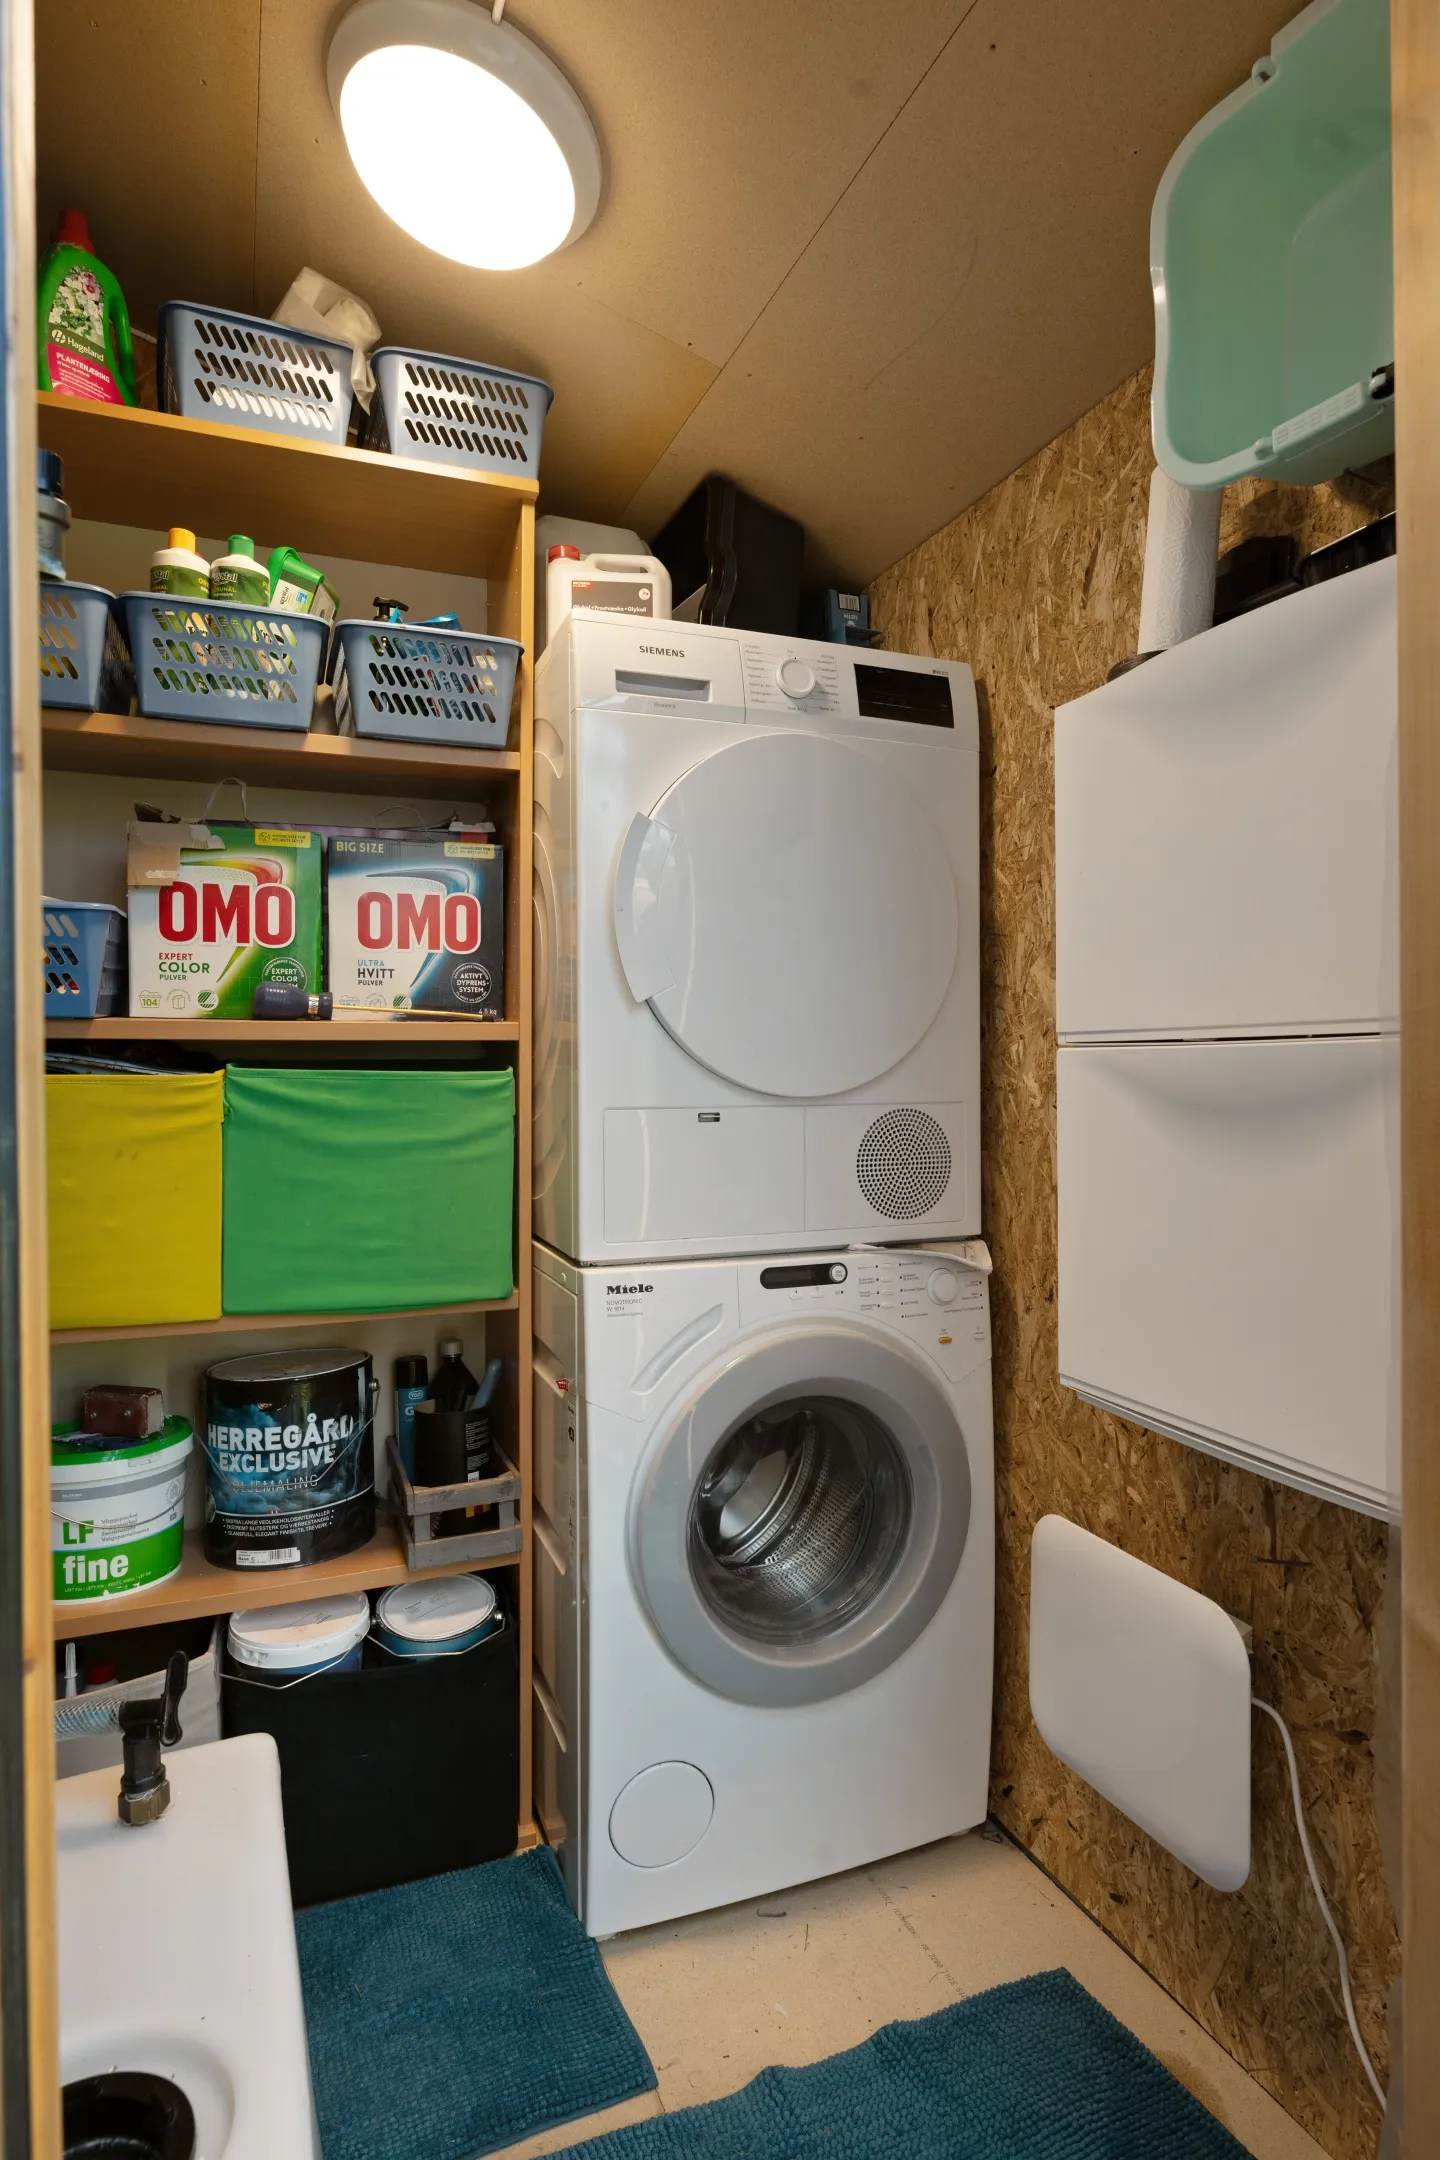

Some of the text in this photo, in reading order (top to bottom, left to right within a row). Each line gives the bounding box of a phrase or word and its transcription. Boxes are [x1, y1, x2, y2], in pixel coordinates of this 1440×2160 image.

[68, 337, 104, 361] Hageland
[56, 352, 110, 383] PLANTENÆRING
[639, 645, 685, 658] SIEMENS
[337, 841, 384, 854] BIG SIZE
[159, 881, 293, 946] OMO
[358, 891, 479, 952] OMO
[158, 952, 193, 961] EXPERT
[357, 959, 385, 967] ULTRA
[158, 961, 210, 974] COLOR
[271, 967, 298, 975] EXPERT
[357, 968, 395, 979] HVITT
[142, 998, 158, 1007] 104
[489, 1008, 497, 1016] kg
[606, 1283, 654, 1295] Miele
[208, 1413, 354, 1451] HERREGÅRD
[219, 1444, 337, 1473] EXCLUSIVE
[233, 1474, 319, 1493] OLJEMALING
[63, 1520, 94, 1545] LF
[305, 1523, 328, 1533] TREVERK
[63, 1554, 129, 1585] fine
